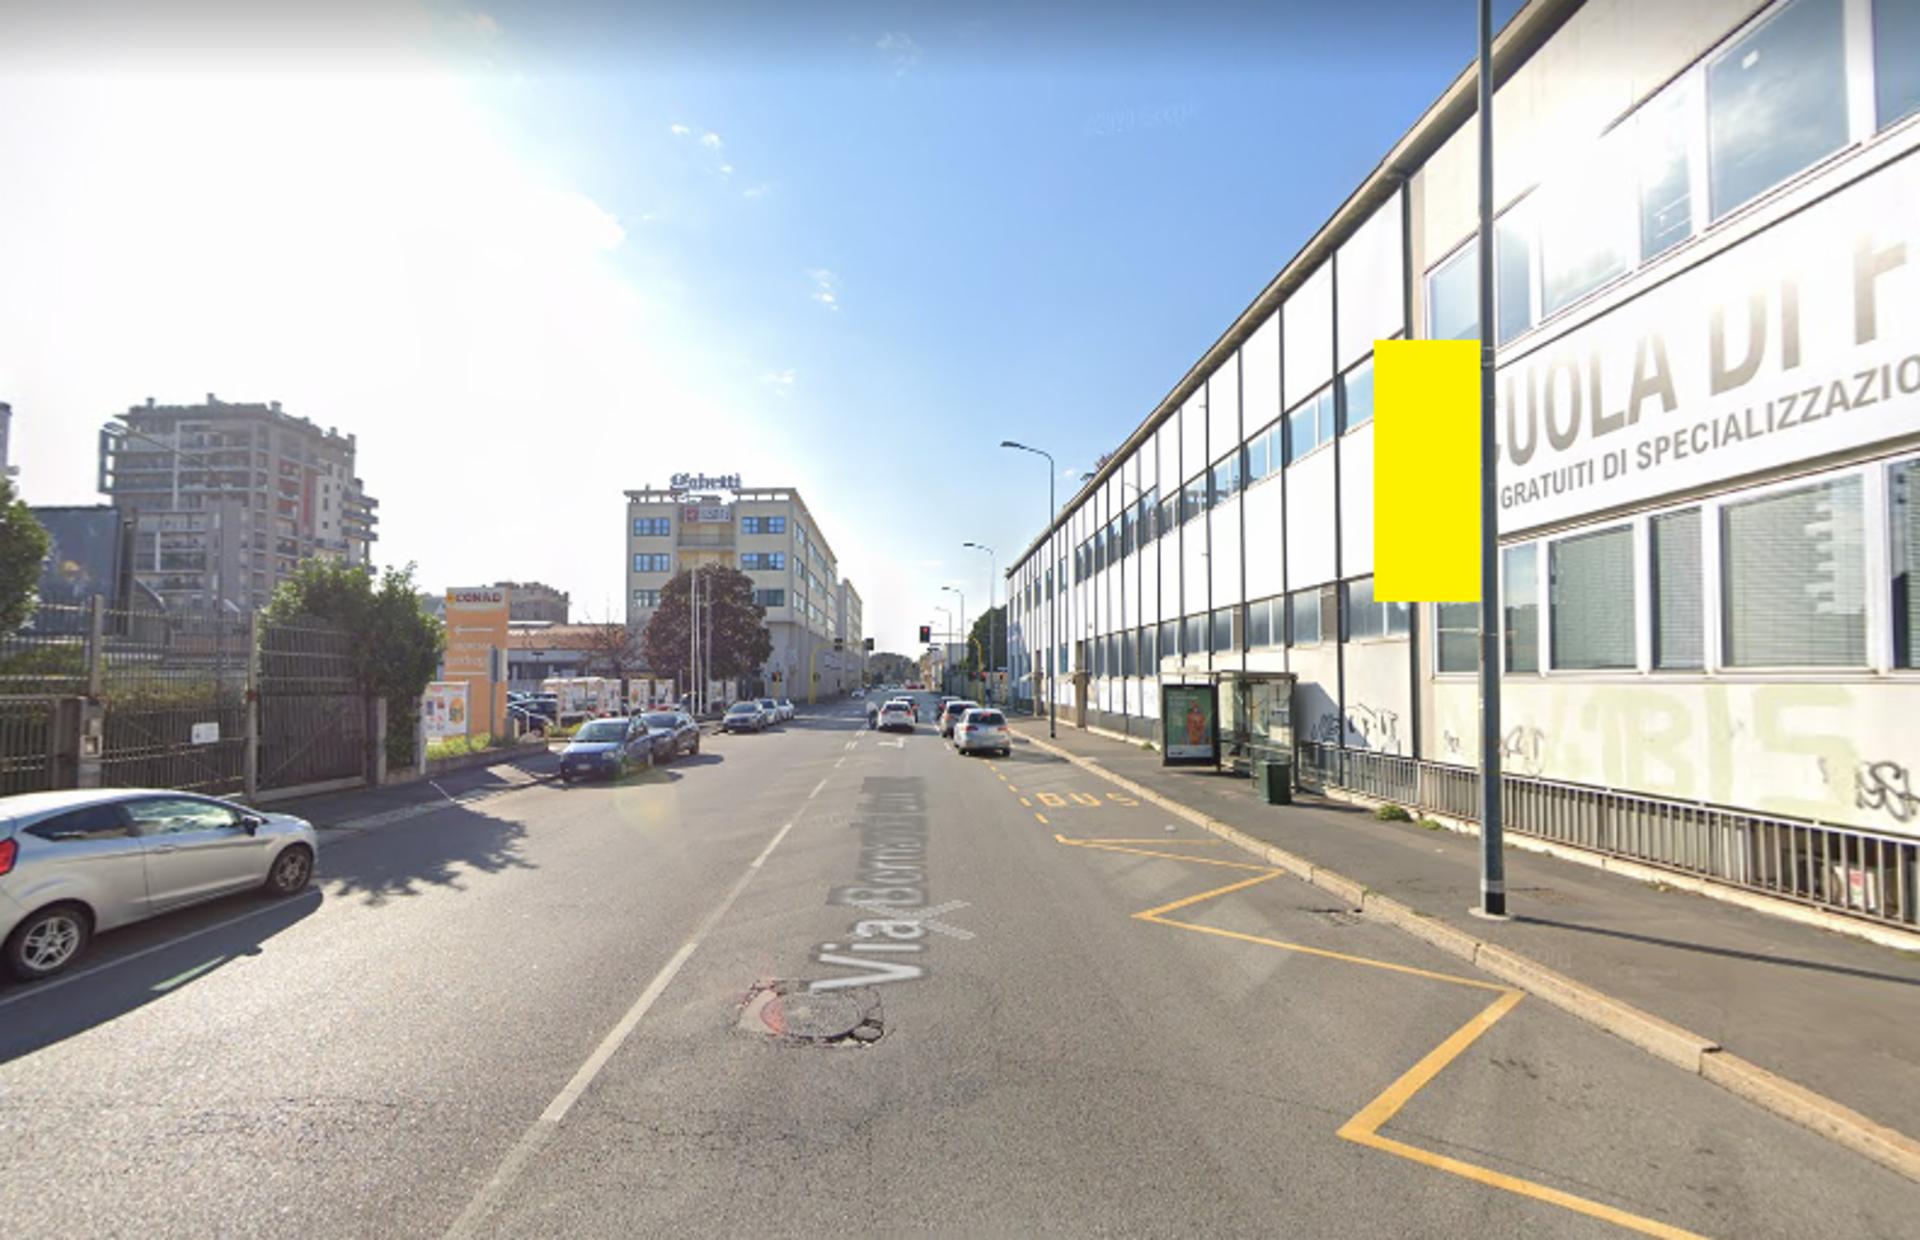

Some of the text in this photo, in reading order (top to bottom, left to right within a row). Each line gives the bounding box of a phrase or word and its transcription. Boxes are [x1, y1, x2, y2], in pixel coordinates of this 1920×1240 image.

[1496, 332, 1679, 466] UOLA
[1501, 354, 1920, 510] GRATUITI DI SPECIALIZZAZIO
